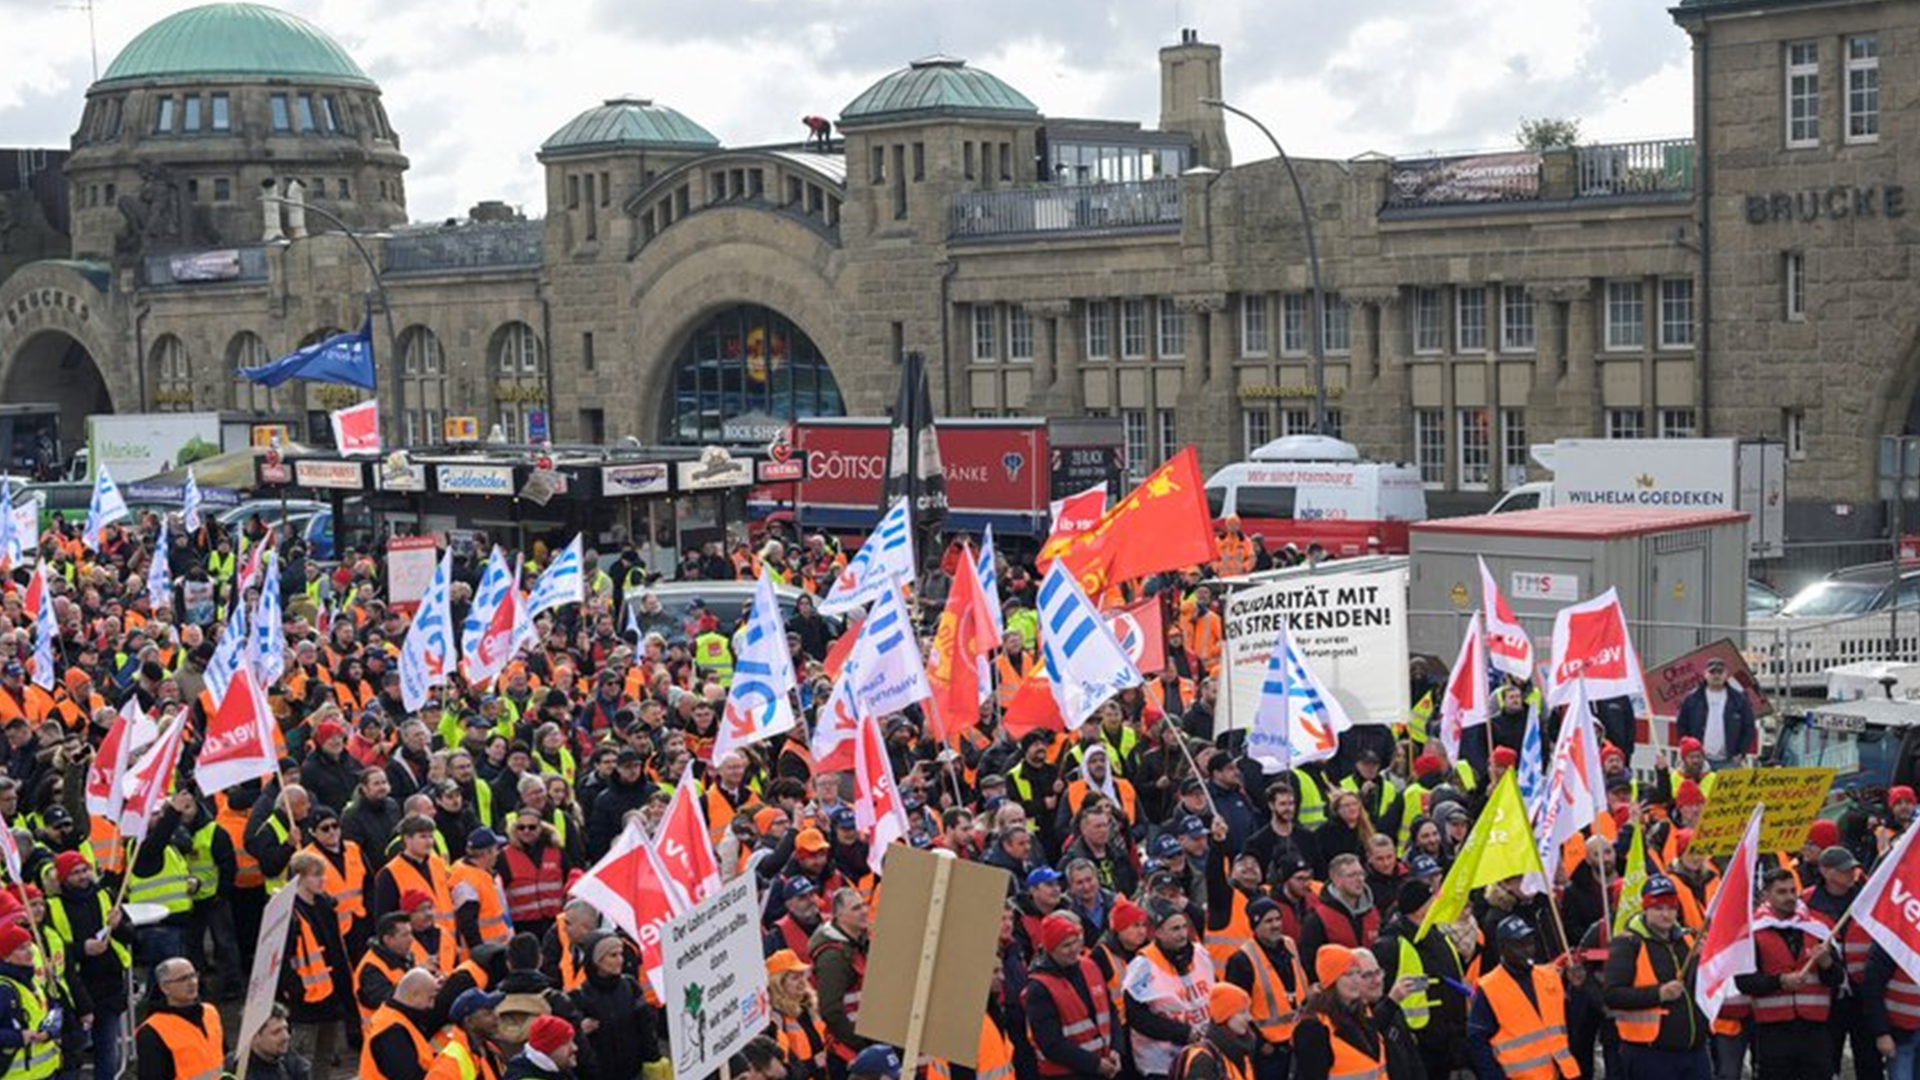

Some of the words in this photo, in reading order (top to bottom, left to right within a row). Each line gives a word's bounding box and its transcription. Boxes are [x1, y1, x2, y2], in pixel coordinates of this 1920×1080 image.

[765, 465, 800, 475] ASTRA
[1247, 471, 1267, 482] Wir
[1270, 471, 1295, 483] sind
[1297, 471, 1354, 486] Hamburg
[1569, 491, 1636, 505] WILHELM
[1639, 490, 1725, 506] GOEDEKEN
[1300, 509, 1324, 518] NDR
[1516, 576, 1552, 593] TMS
[1337, 586, 1379, 606] MIT
